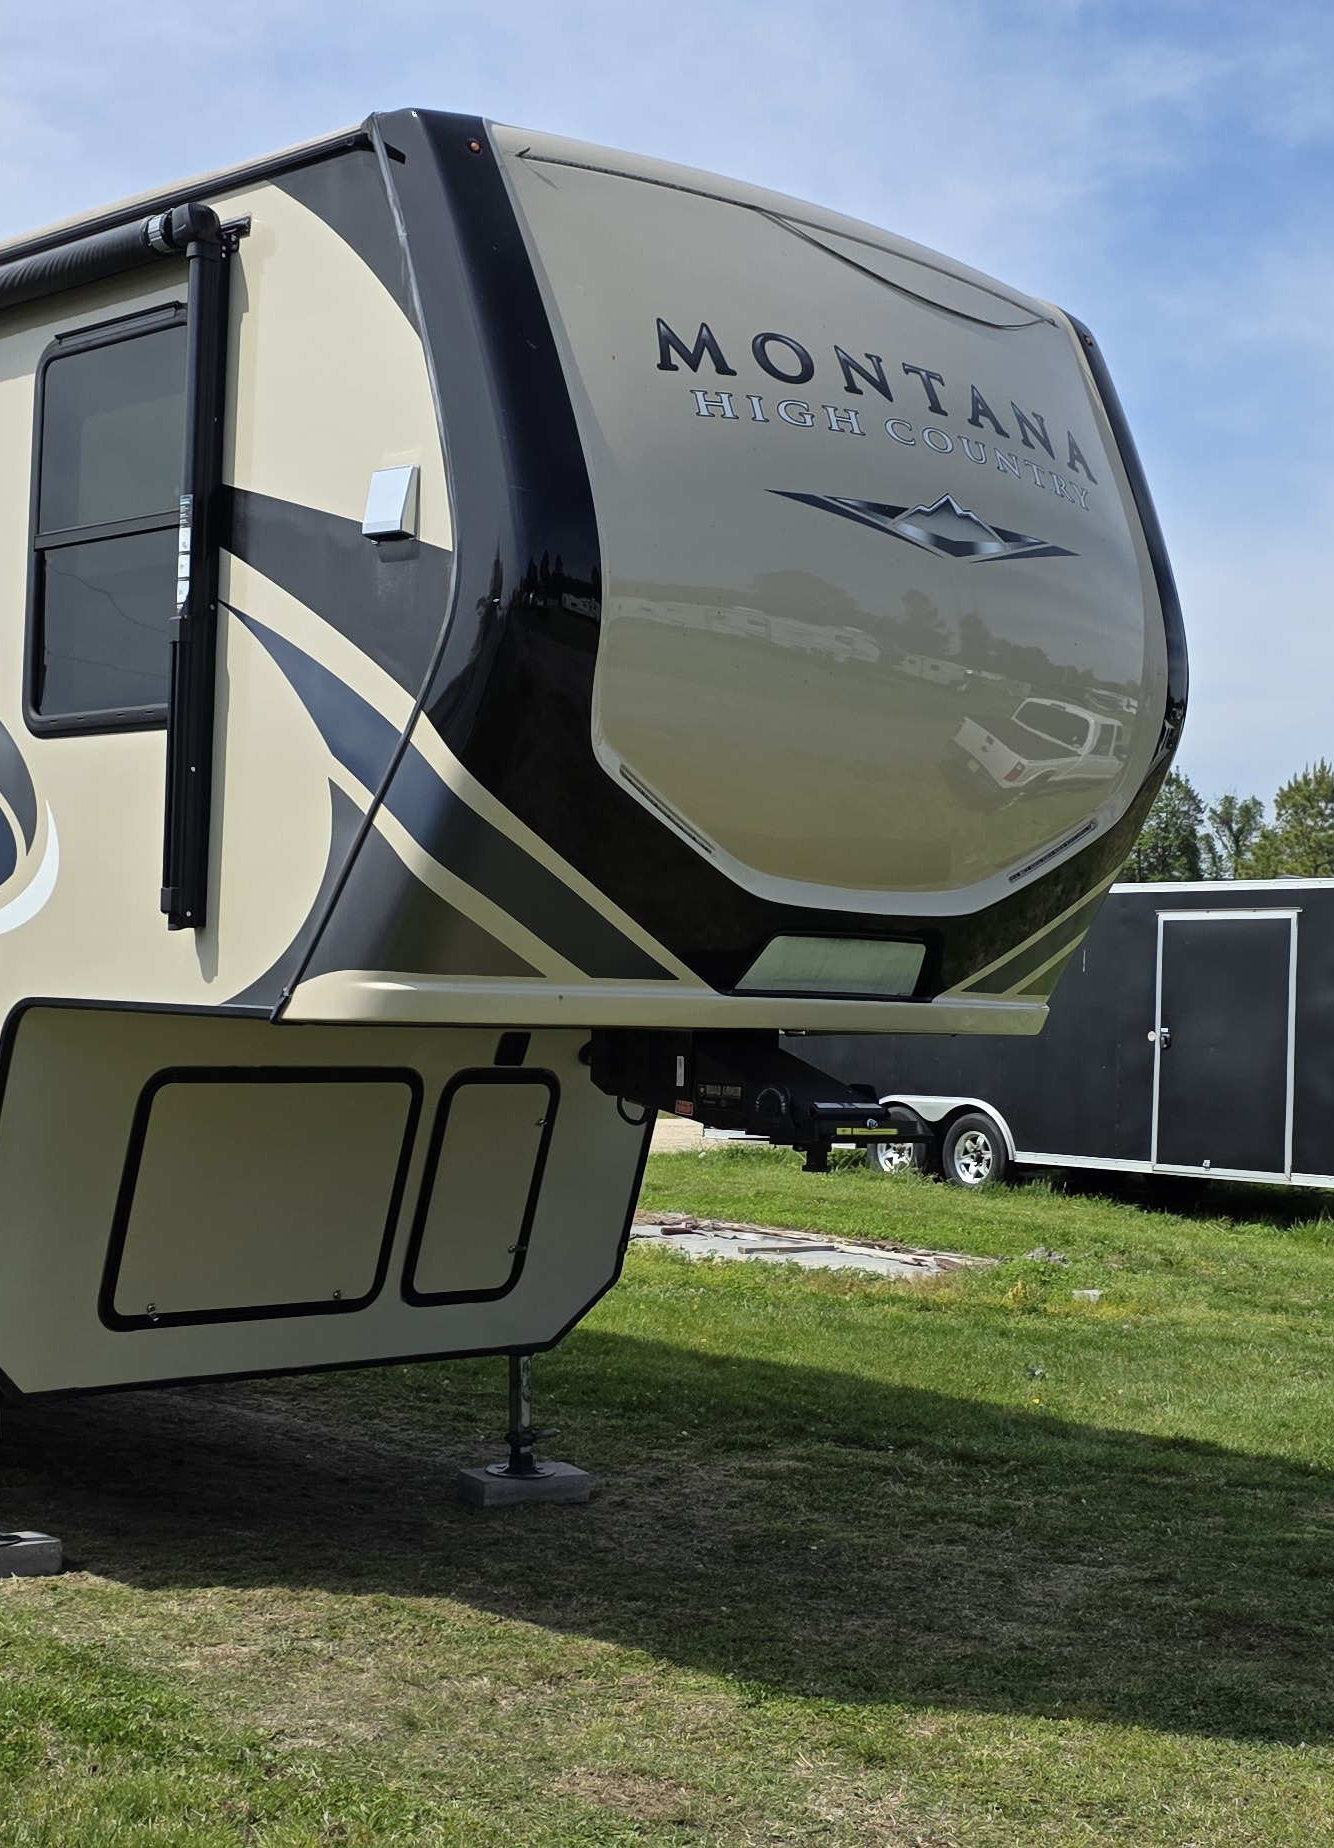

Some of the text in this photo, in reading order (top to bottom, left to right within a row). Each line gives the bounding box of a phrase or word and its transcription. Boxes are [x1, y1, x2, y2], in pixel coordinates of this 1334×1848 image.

[656, 317, 1098, 485] MONTANA
[689, 389, 1090, 511] HIGH COUNTRY
